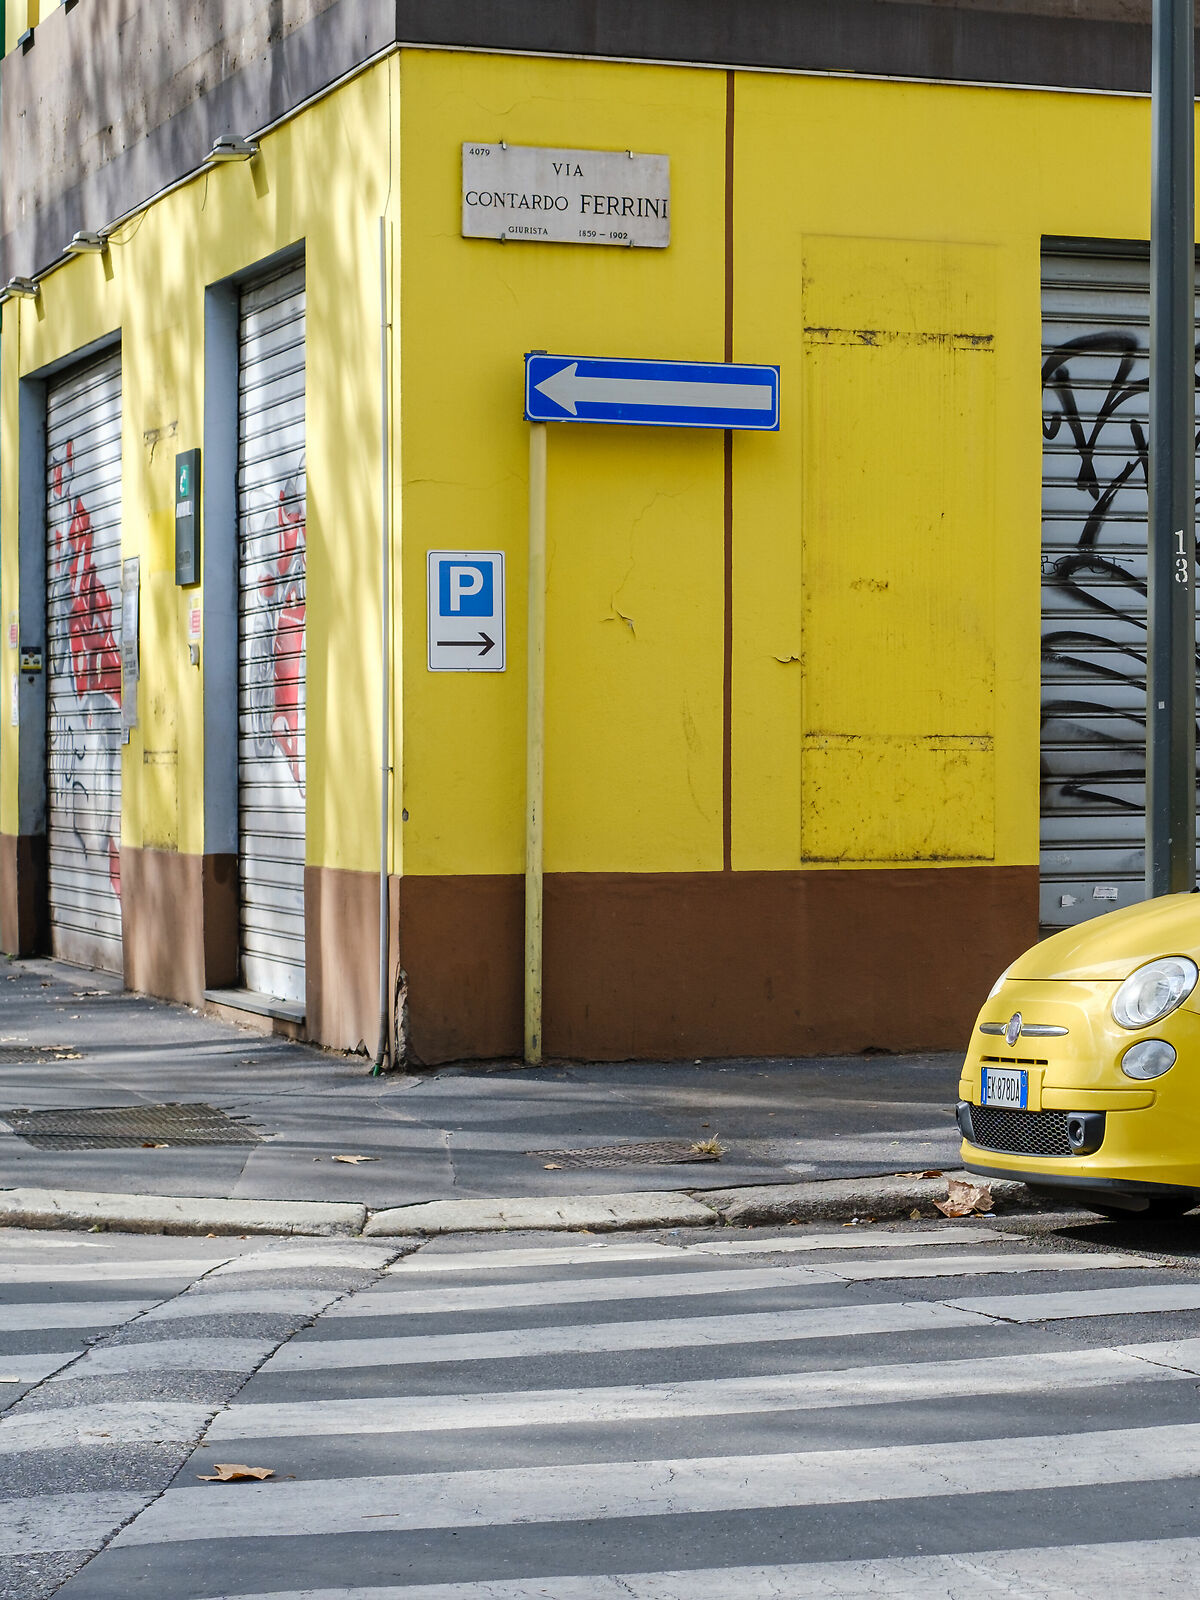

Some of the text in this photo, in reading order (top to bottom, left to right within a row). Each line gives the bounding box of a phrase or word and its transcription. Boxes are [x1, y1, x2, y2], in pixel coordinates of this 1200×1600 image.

[469, 148, 491, 157] 4079
[552, 162, 584, 177] VIA
[465, 190, 668, 219] CONTARDO FERRINI
[508, 226, 548, 236] GIURISTA
[578, 230, 597, 238] 1859
[609, 232, 628, 240] 1902
[449, 566, 484, 612] P
[997, 1077, 1020, 1102] 878DA
